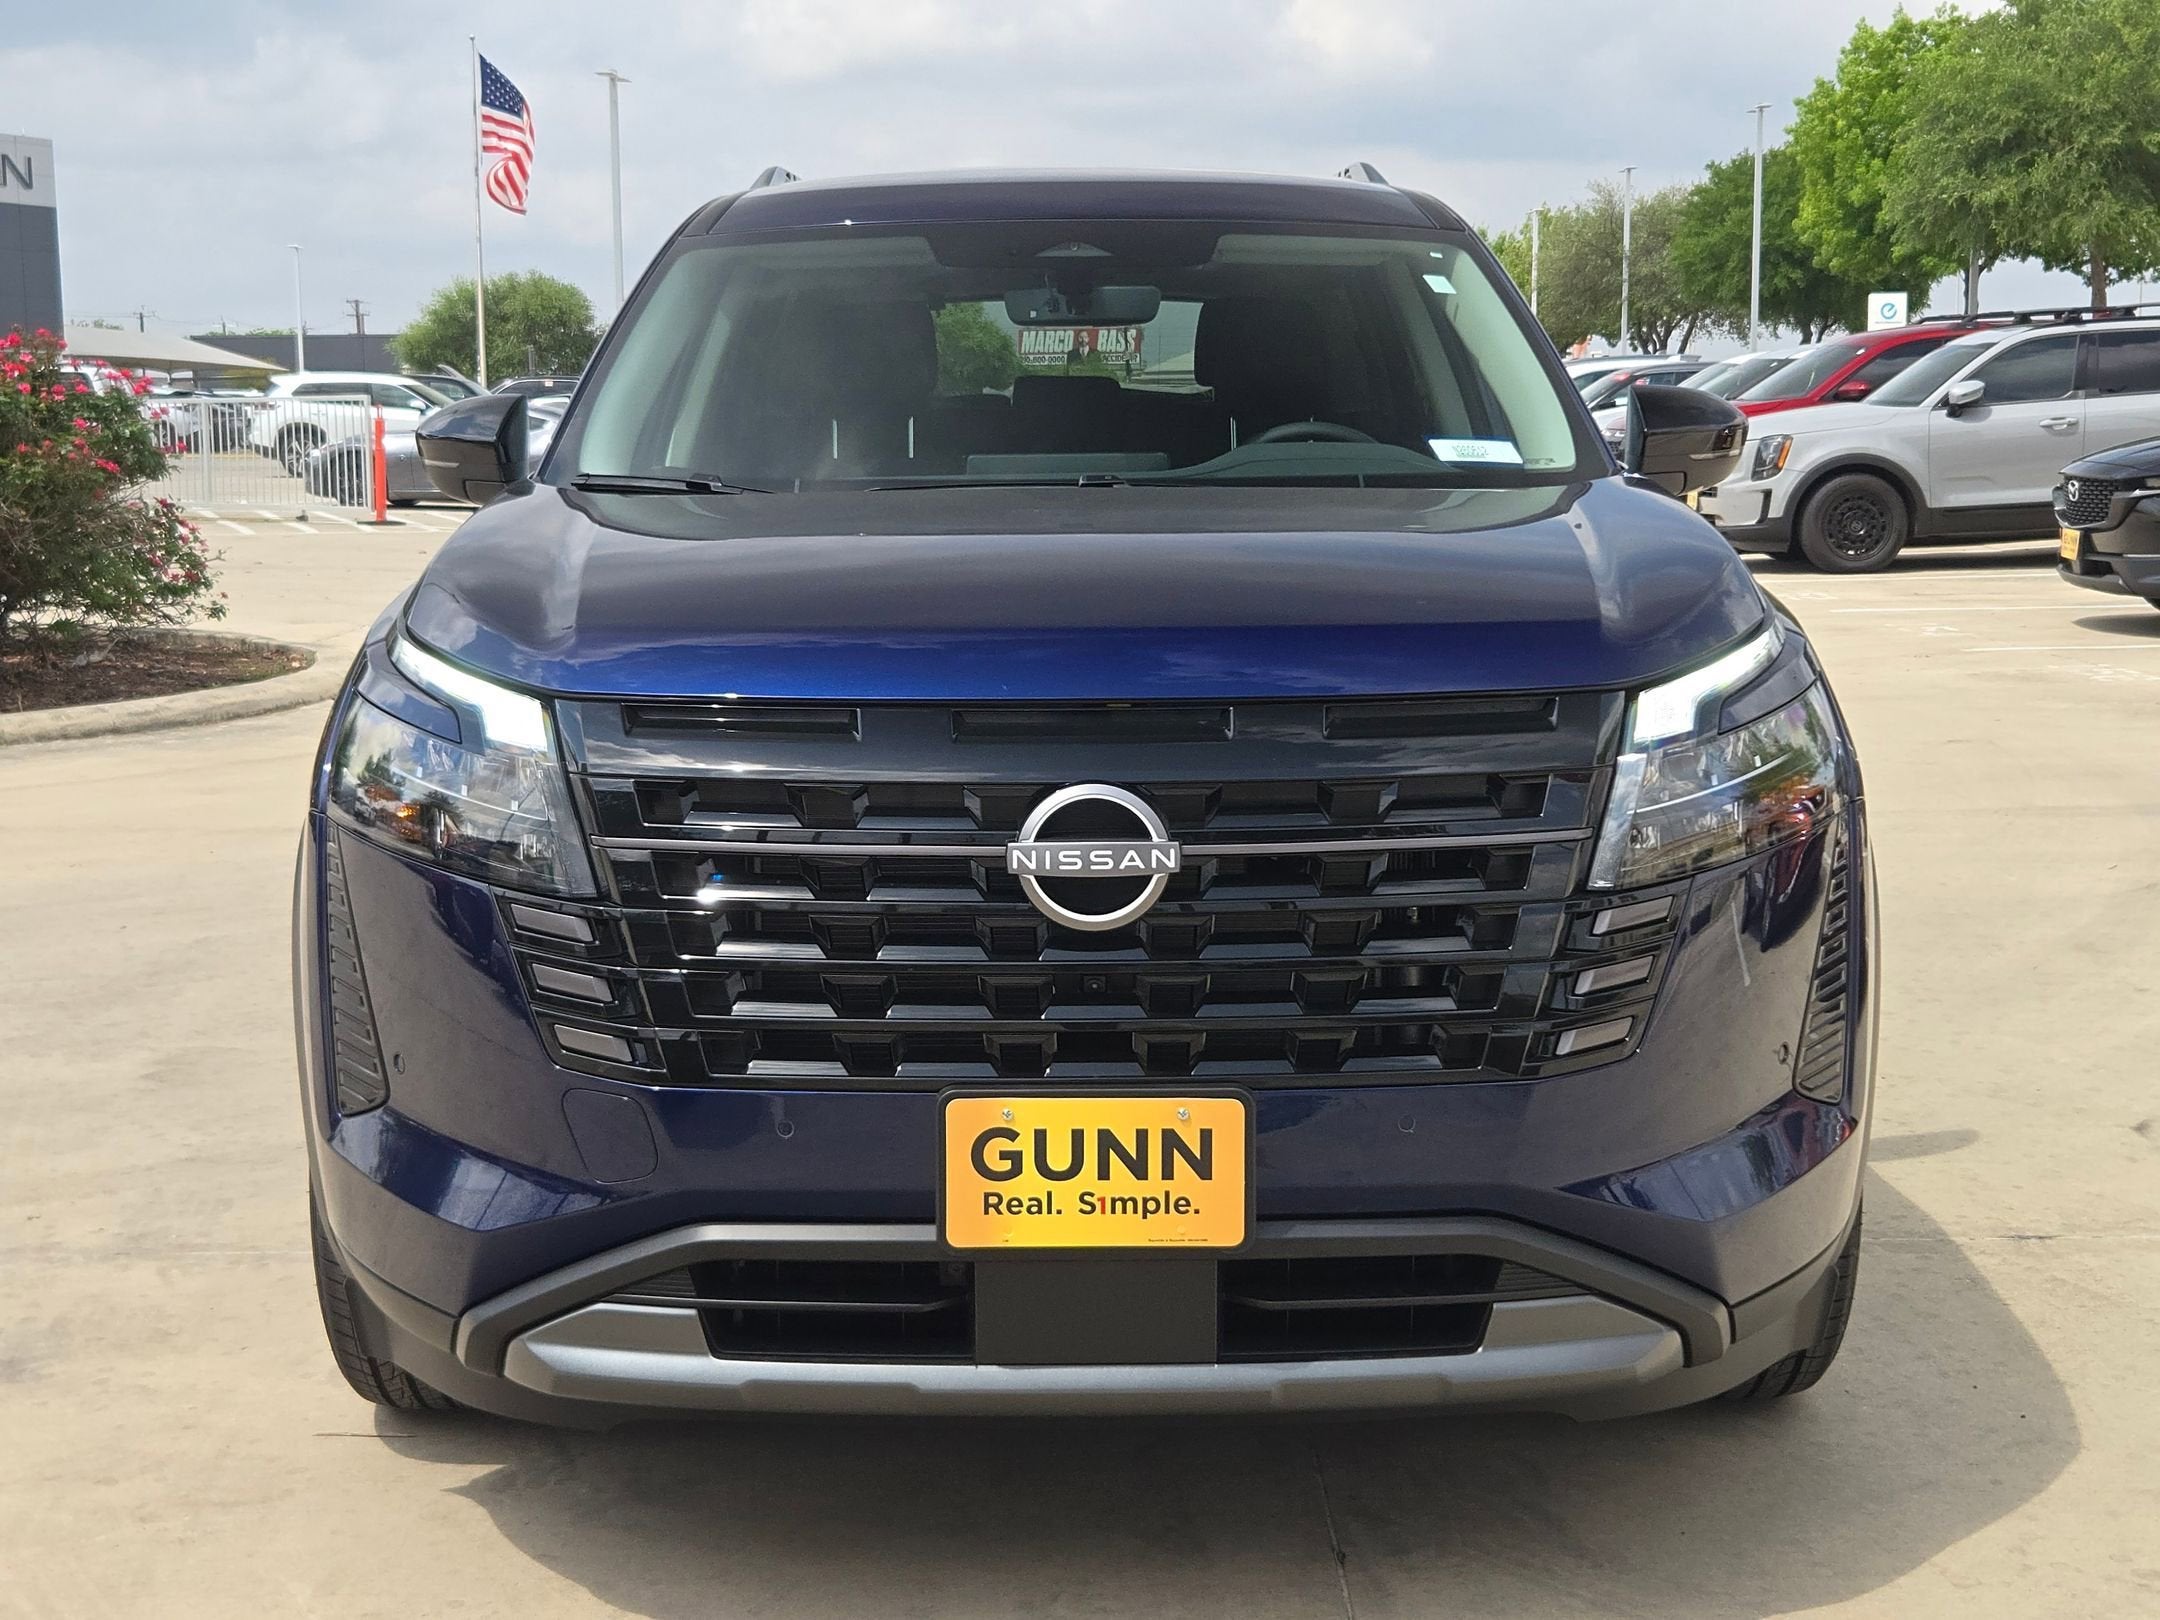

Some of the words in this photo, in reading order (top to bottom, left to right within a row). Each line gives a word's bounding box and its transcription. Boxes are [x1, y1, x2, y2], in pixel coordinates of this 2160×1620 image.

[1021, 331, 1074, 353] MARCO
[1097, 329, 1136, 352] BASS
[1012, 849, 1176, 870] NISSAN
[970, 1126, 1213, 1182] GUNN
[983, 1191, 1063, 1216] Real.
[1078, 1190, 1201, 1220] S1mple.
